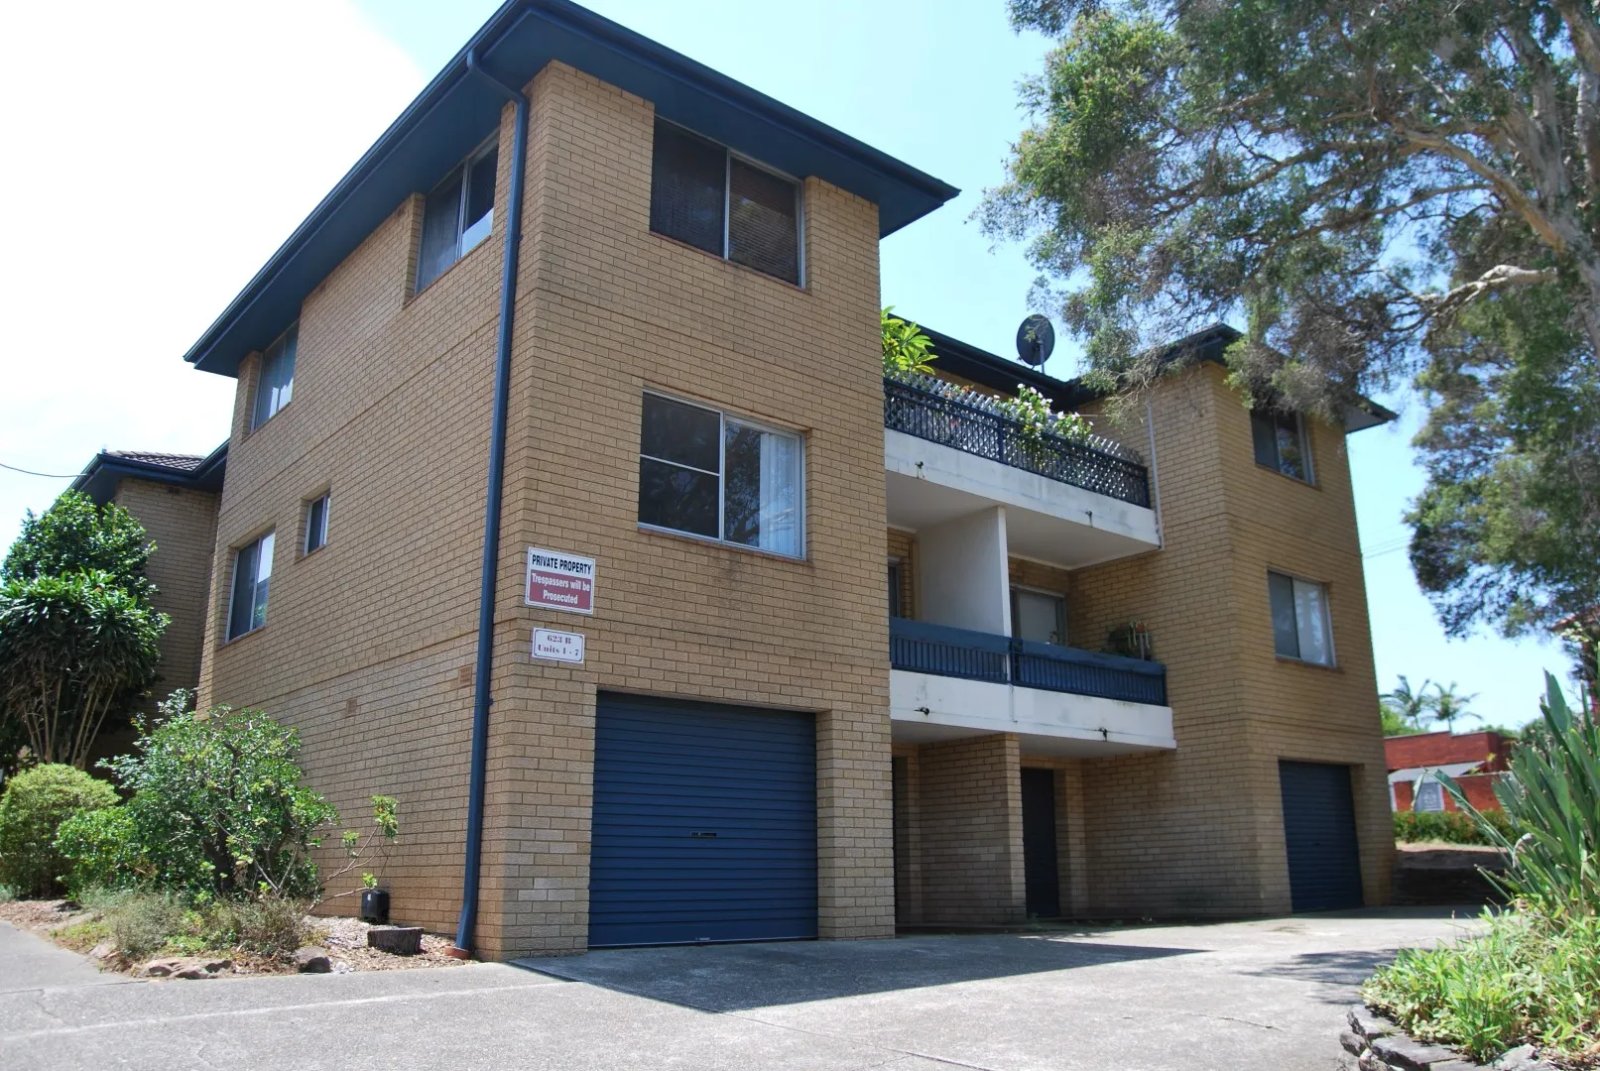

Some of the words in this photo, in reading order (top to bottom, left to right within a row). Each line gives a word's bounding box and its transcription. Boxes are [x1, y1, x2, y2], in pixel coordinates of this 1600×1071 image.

[532, 554, 558, 569] PRIVATE
[559, 560, 592, 575] PROPERTY
[532, 573, 569, 588] Trespassers
[570, 580, 582, 590] will
[582, 582, 591, 592] be
[543, 589, 579, 604] Prosecuted
[547, 634, 563, 644] 623
[537, 644, 560, 654] Units
